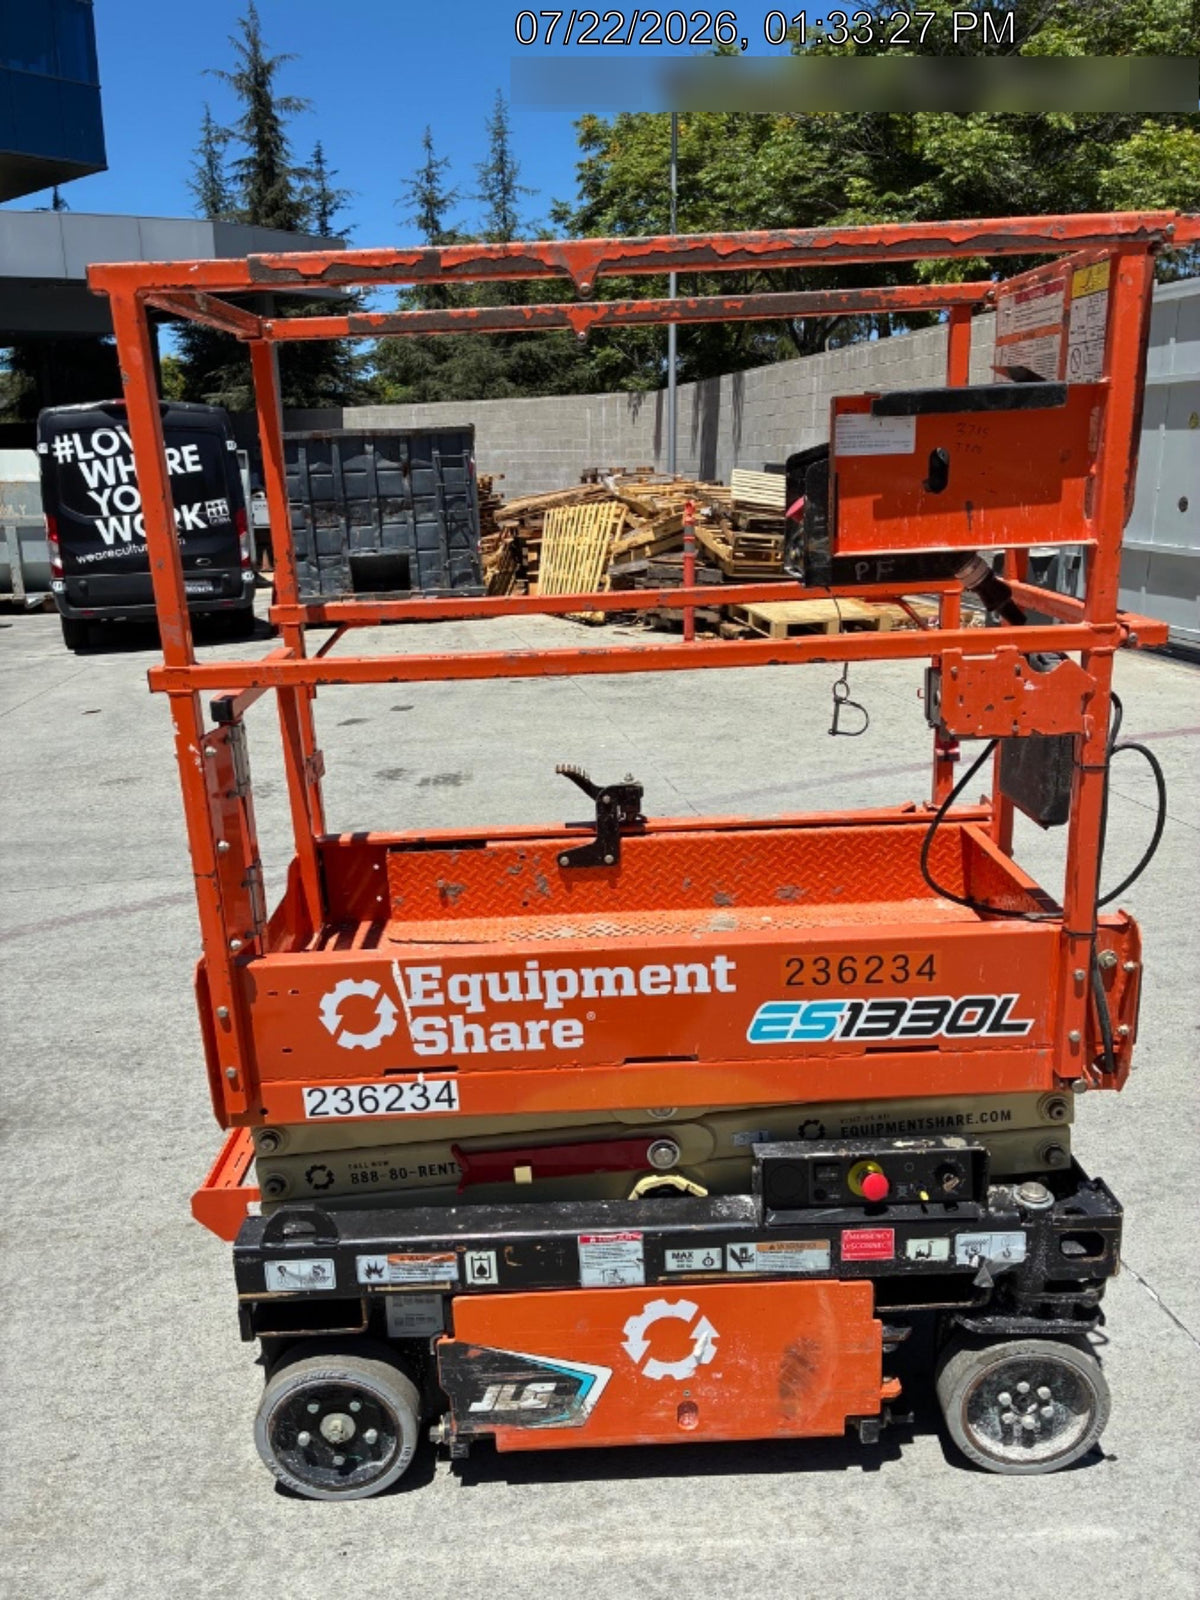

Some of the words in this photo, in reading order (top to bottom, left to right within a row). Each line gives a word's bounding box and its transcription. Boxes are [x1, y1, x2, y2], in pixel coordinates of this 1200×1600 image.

[52, 425, 134, 464] #LO
[78, 444, 203, 489] WHRE
[87, 484, 142, 518] YO
[95, 503, 208, 545] WK
[404, 954, 737, 1013] Equipment
[785, 954, 937, 986] 236234
[411, 1015, 584, 1056] Share
[747, 993, 1035, 1043] ES1330L
[306, 1080, 457, 1117] 236234
[841, 1110, 1011, 1138] EQUIPMENTSHARE.COM
[671, 1251, 694, 1260] MAX
[468, 1382, 557, 1412] JLG
